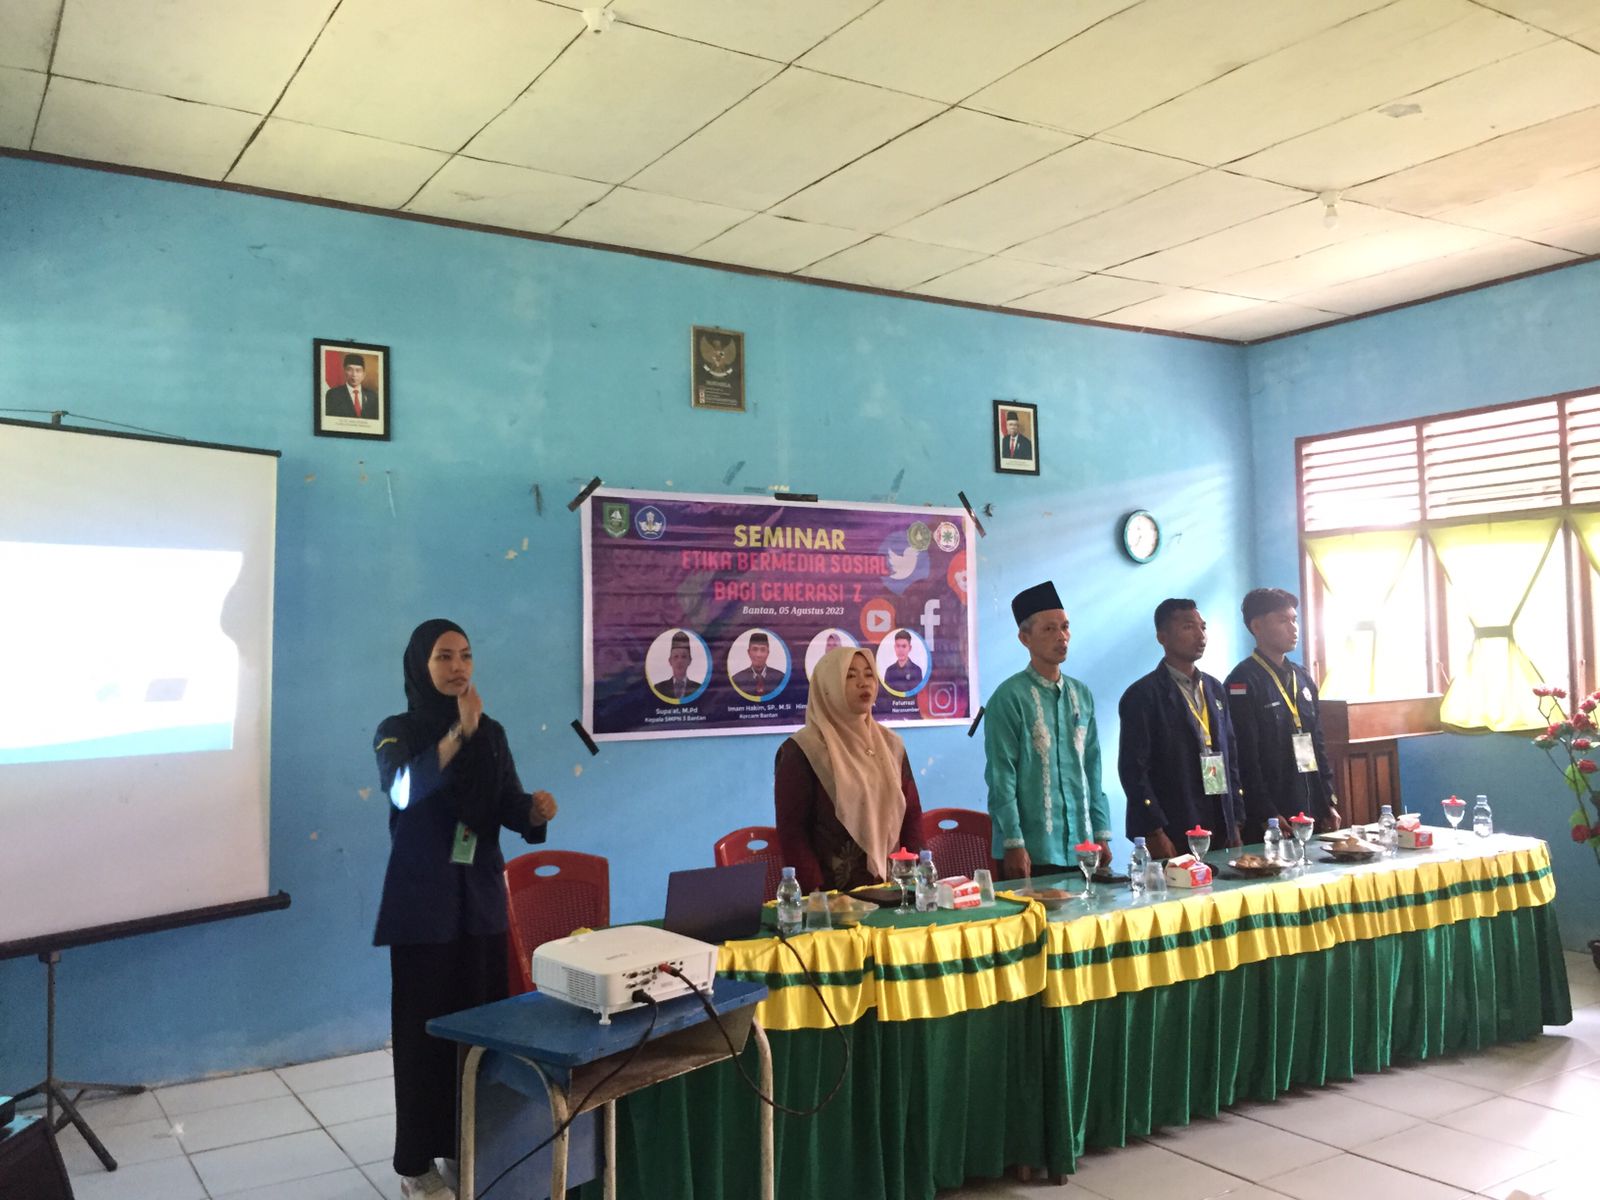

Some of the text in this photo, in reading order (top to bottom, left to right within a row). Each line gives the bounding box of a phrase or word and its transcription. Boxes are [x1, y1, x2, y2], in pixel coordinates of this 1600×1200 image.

[734, 524, 845, 550] SEMINAR
[681, 551, 889, 575] ETIKA BERMEDIA SOSIAL
[714, 581, 862, 603] BAGI GENERASI Z
[742, 606, 844, 616] Bantan, 05 Agustus 2023
